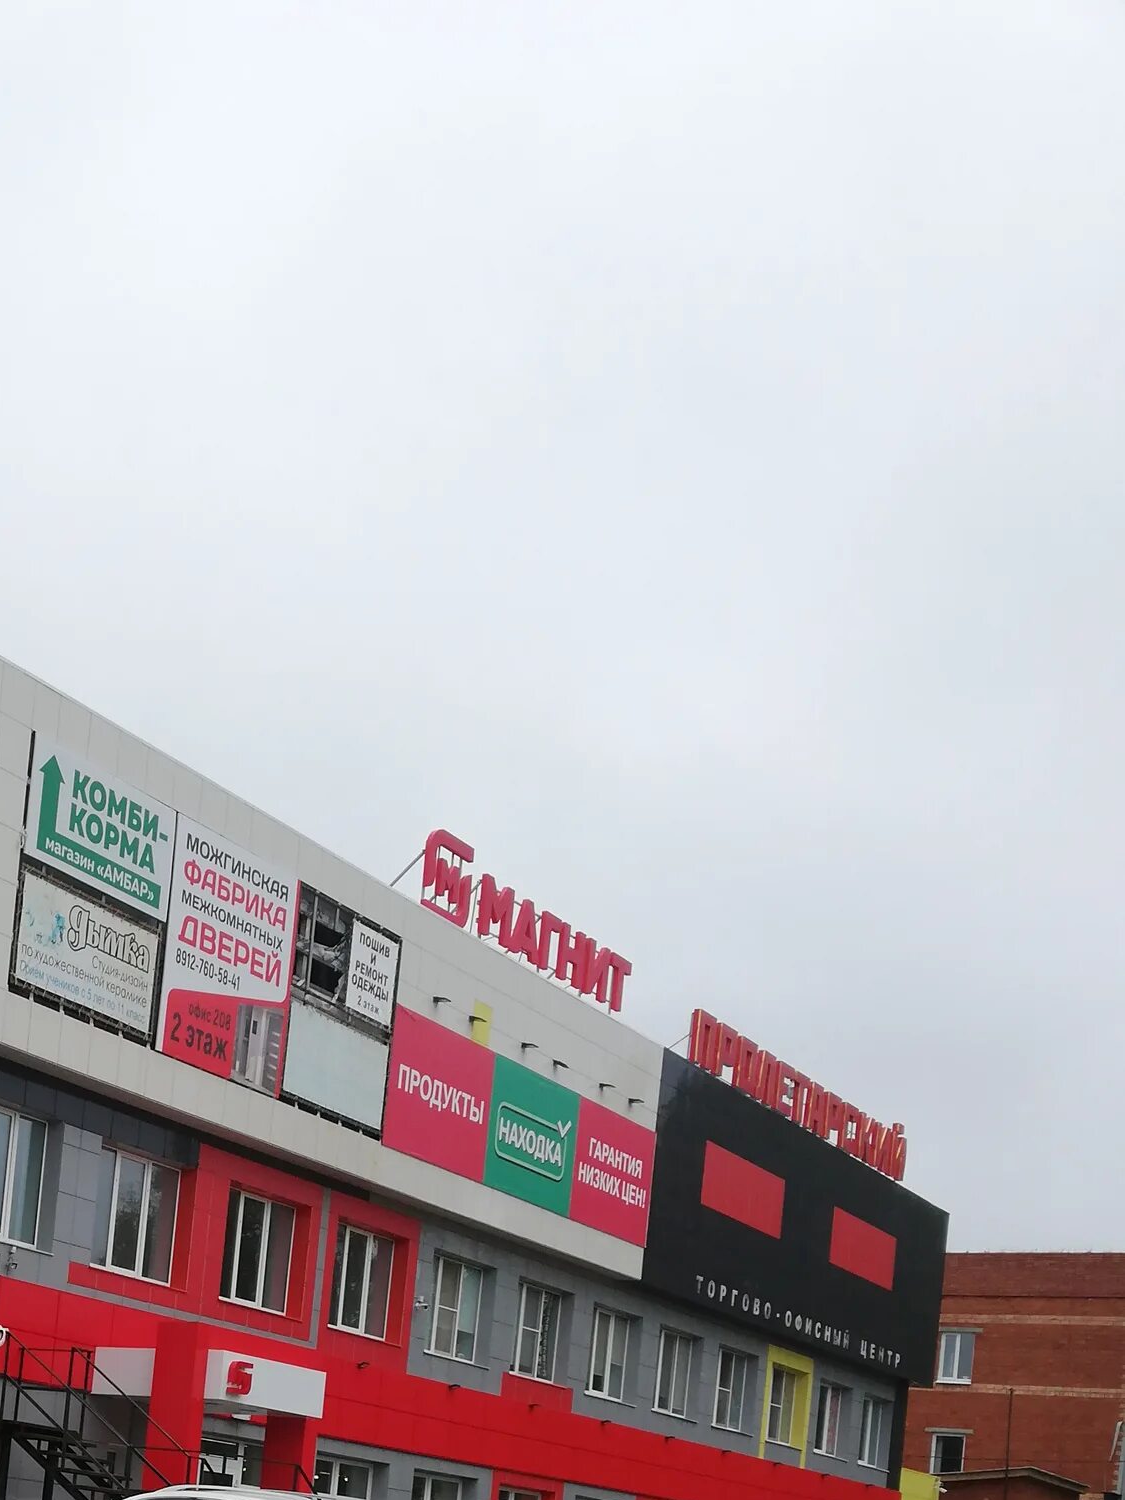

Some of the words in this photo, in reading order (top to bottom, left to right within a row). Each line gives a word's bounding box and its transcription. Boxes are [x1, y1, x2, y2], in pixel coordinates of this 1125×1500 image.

[72, 769, 168, 843] КОМБИ-
[69, 802, 155, 874] КОРМА
[45, 837, 95, 873] магазин
[97, 863, 155, 901] «АМБАР»
[186, 833, 289, 902] МОЖГИНСКАЯ
[181, 889, 284, 952] МЕЖКОМНАТНЫХ
[183, 859, 288, 932] ФАБРИКА
[21, 943, 34, 957] по
[34, 949, 105, 988] художественной
[178, 915, 282, 987] ДВЕРЕЙ
[359, 931, 390, 958] ПОШИВ
[370, 953, 377, 966] И
[477, 873, 633, 1012] МАГНИТ
[175, 948, 241, 991] 8912-760-58-41
[351, 973, 389, 1002] ОДЕЖДЫ
[355, 959, 389, 987] РЕМОНТ
[188, 1002, 212, 1023] офис
[357, 995, 362, 1006] 2
[170, 1012, 182, 1042] 2
[185, 1024, 228, 1062] этаж
[397, 1063, 485, 1125] ПРОДУКТЫ
[687, 1008, 907, 1182] ПРОЛЕТАРСКИЙ
[498, 1116, 563, 1167] НАХОДКА
[588, 1137, 643, 1179] ГАРАНТИЯ
[577, 1161, 621, 1199] НИЗКИХ
[621, 1184, 647, 1208] ЦЕН!
[859, 1339, 902, 1369] ЦЕНТР
